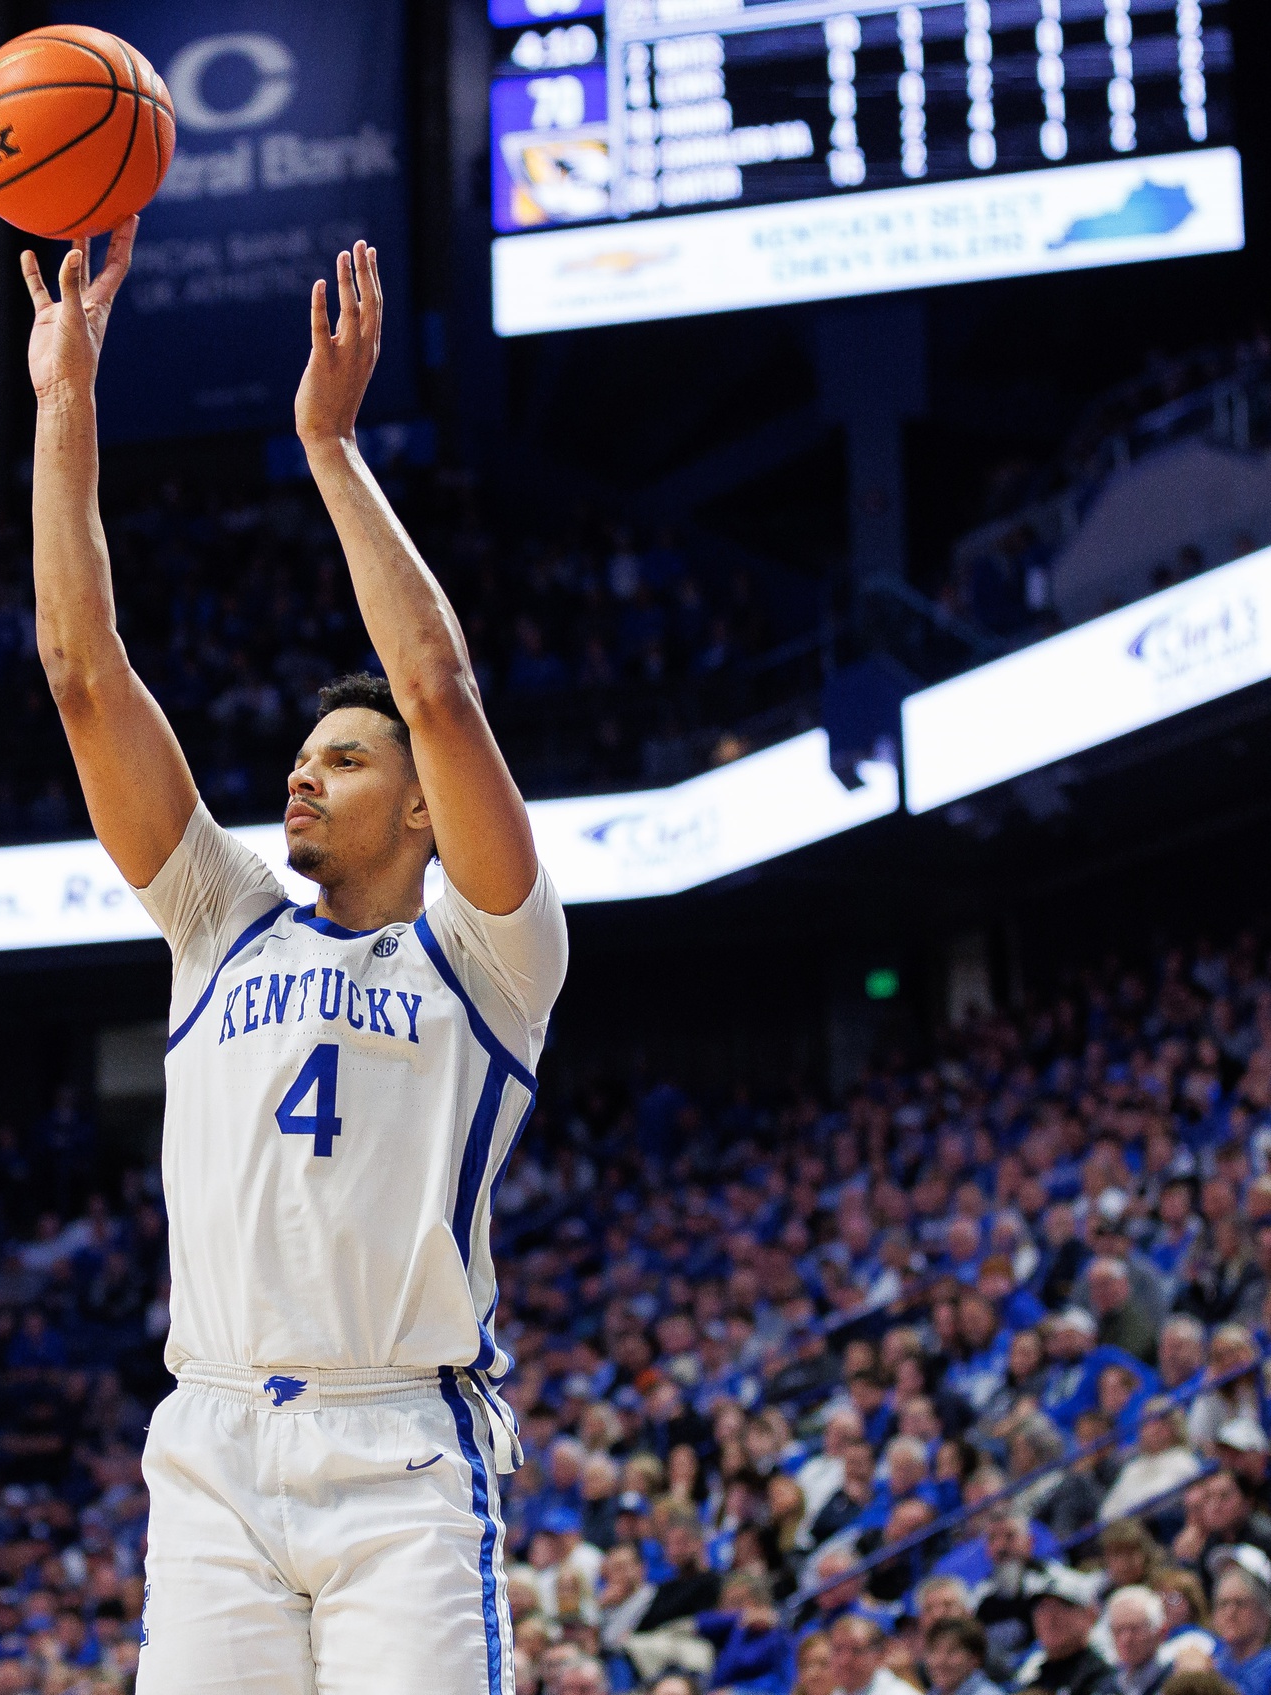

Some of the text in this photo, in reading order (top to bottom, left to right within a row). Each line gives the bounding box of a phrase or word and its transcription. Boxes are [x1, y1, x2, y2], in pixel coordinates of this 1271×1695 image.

[261, 124, 396, 188] Bank
[374, 938, 398, 957] SEC
[219, 968, 422, 1045] KENTUCKY
[275, 1043, 342, 1157] 4
